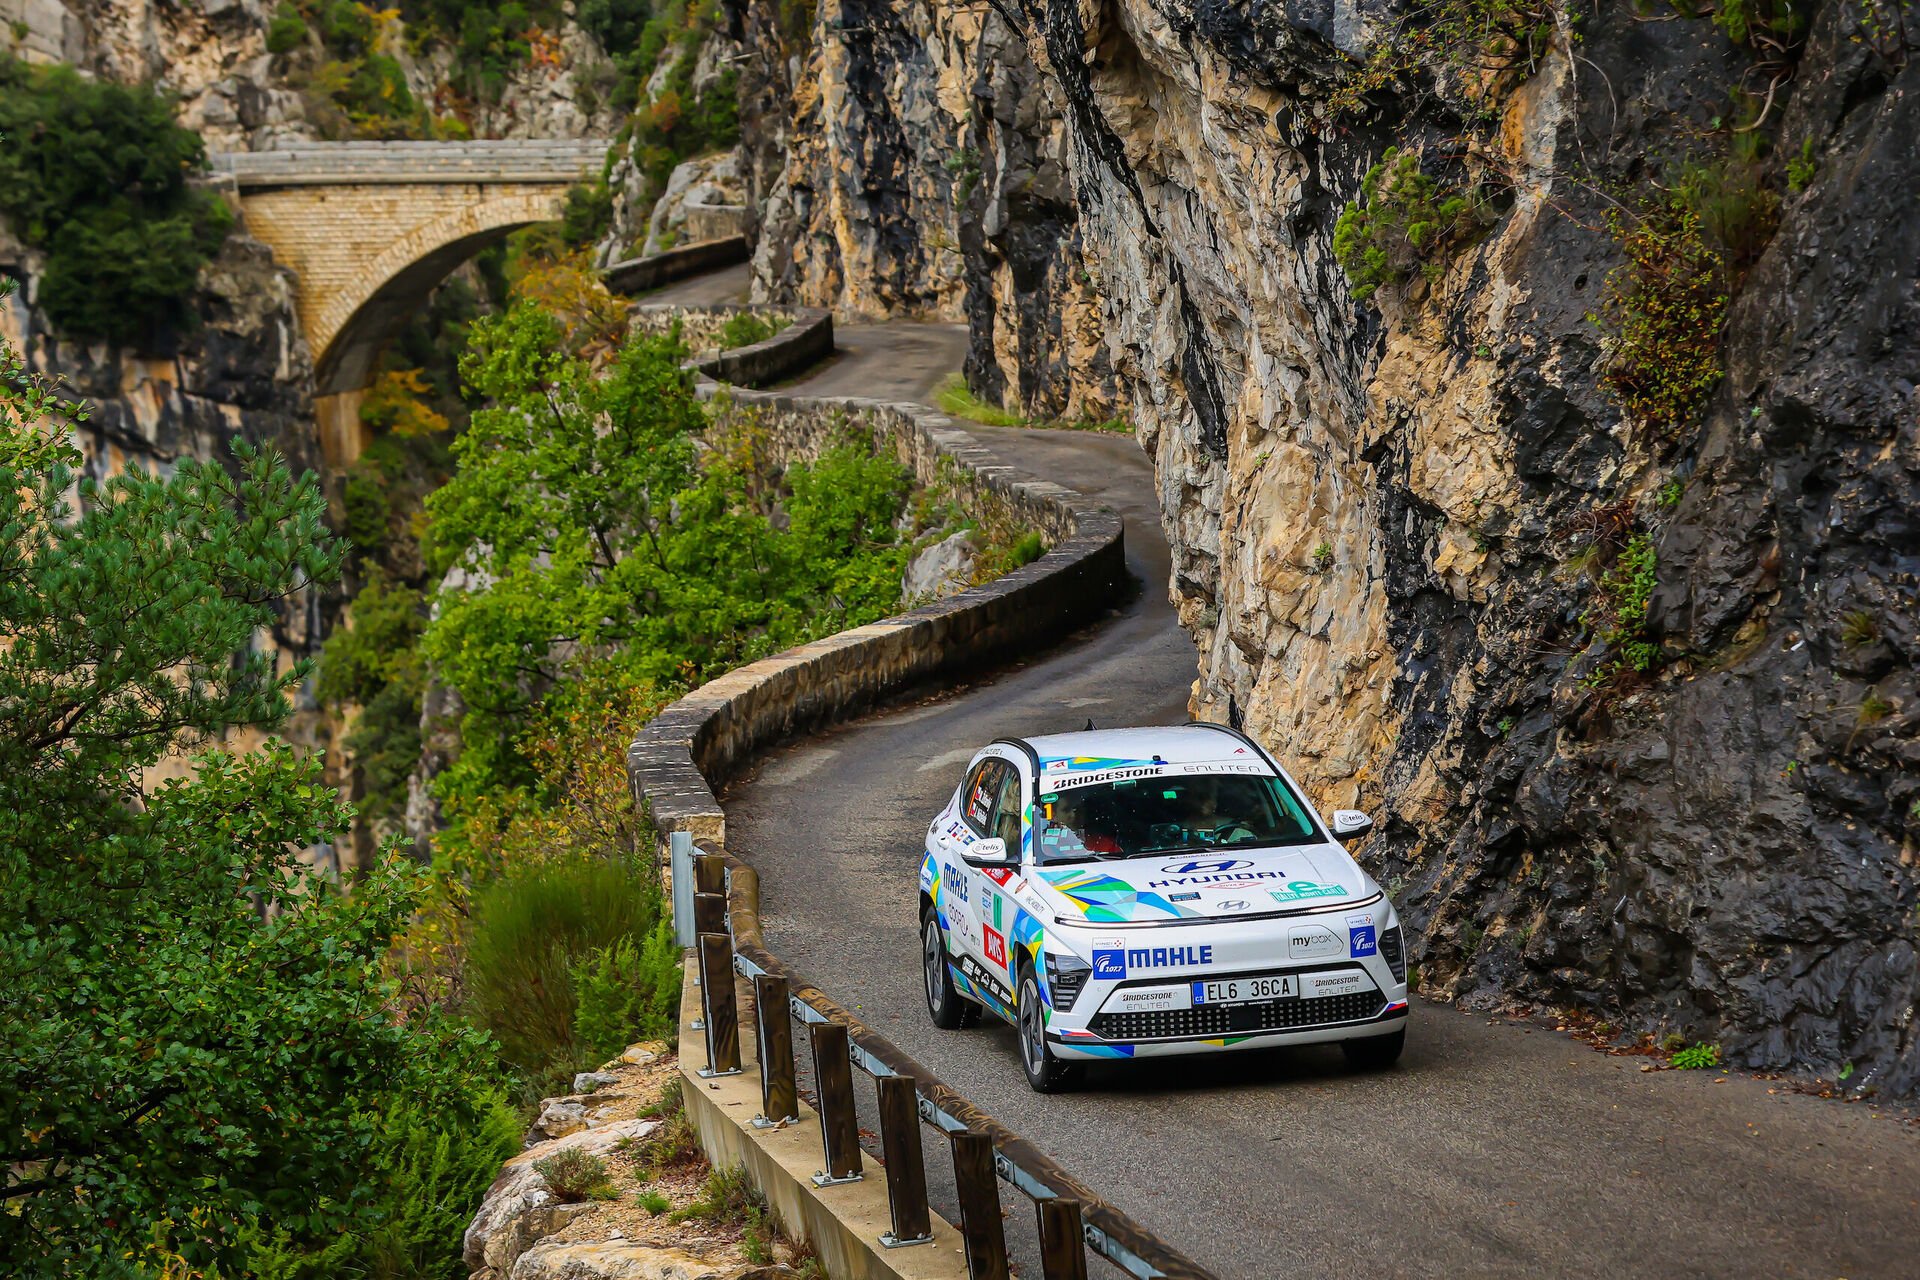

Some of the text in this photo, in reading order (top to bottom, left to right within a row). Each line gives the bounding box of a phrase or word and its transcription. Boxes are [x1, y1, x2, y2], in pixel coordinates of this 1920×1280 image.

[1184, 765, 1261, 774] ENLITEN
[1053, 767, 1163, 790] BRIDGESTONE
[1043, 803, 1053, 820] 1
[982, 843, 1000, 851] telis
[943, 862, 968, 903] MAHLE
[1148, 871, 1287, 888] HYUNDAI
[987, 931, 1003, 963] AVIS
[1292, 934, 1332, 946] mybox
[1127, 945, 1213, 968] MAHLE
[1315, 975, 1360, 987] BRIDGESTONE
[1122, 992, 1173, 1001] BRIDGESTONE
[1207, 978, 1290, 1001] EL6 36CA
[1318, 985, 1357, 996] ENLITEN
[1126, 1002, 1170, 1011] ENLITEN
